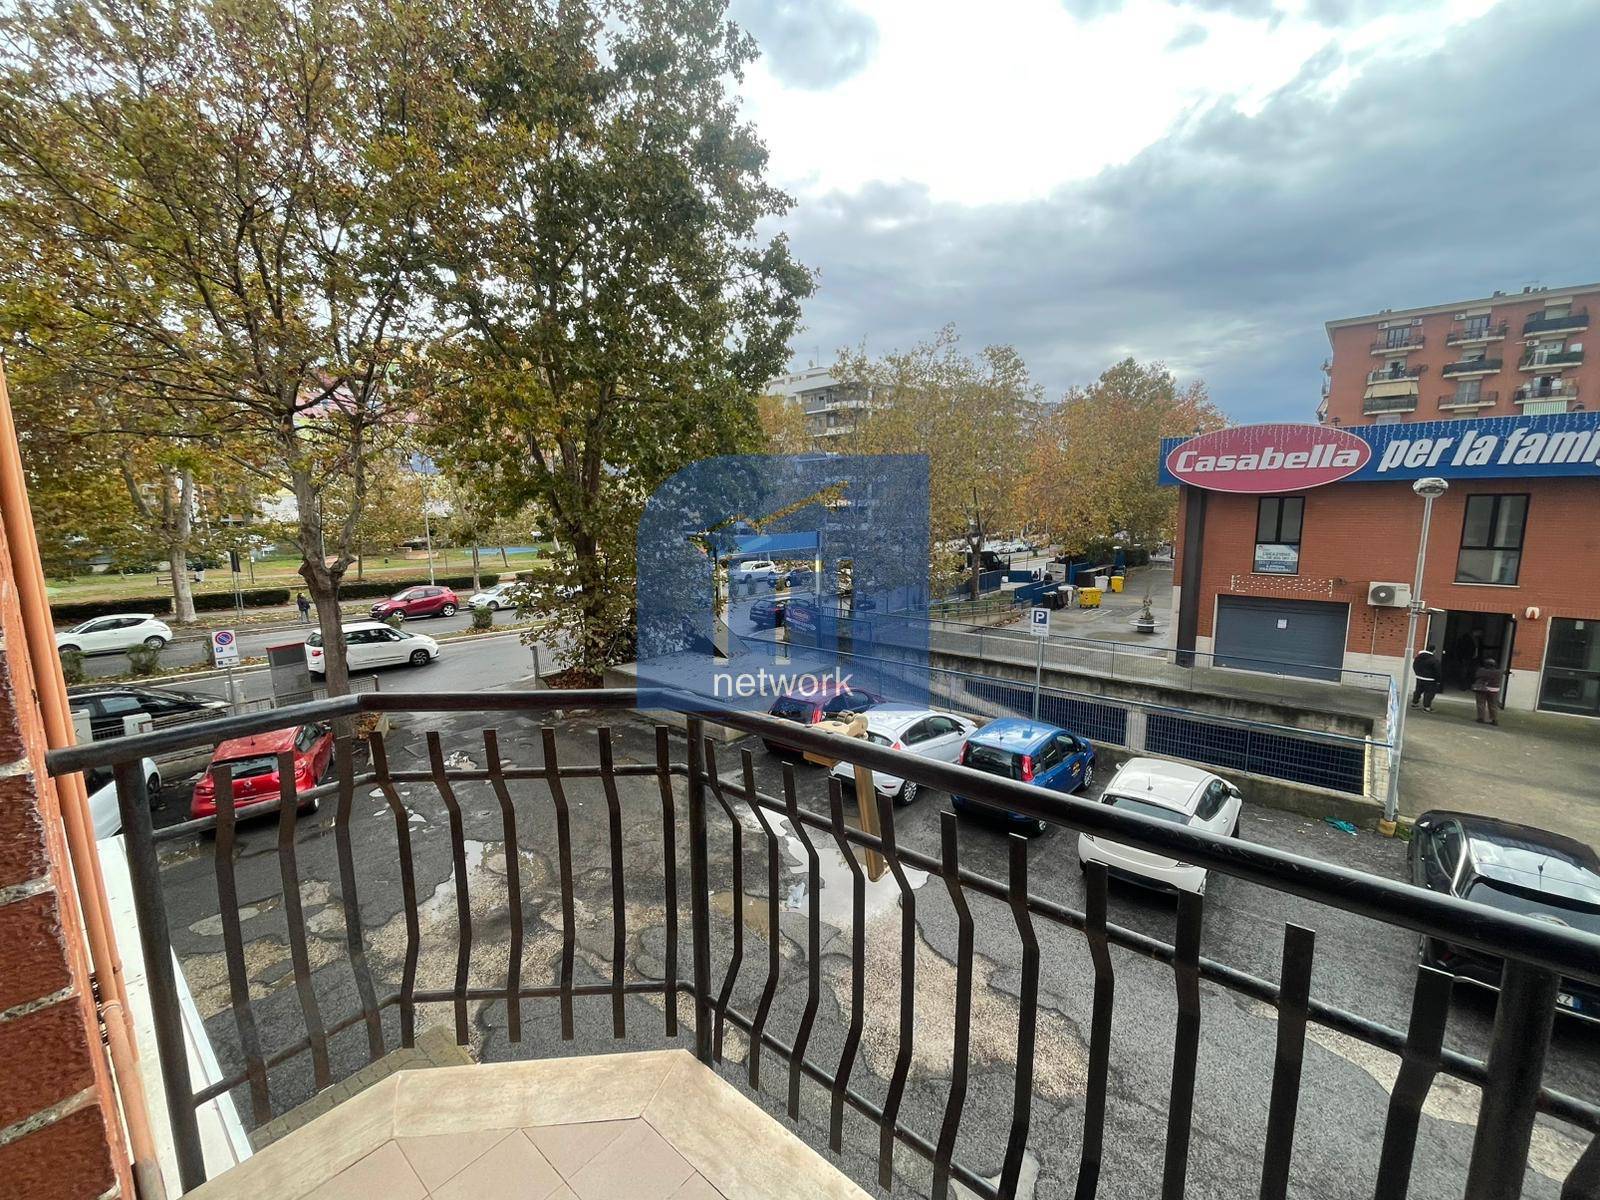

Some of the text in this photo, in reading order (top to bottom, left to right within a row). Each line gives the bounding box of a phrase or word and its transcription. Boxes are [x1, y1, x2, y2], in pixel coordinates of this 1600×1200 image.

[1176, 444, 1359, 472] Casabella
[1377, 427, 1600, 472] per la fami
[1035, 611, 1045, 623] P
